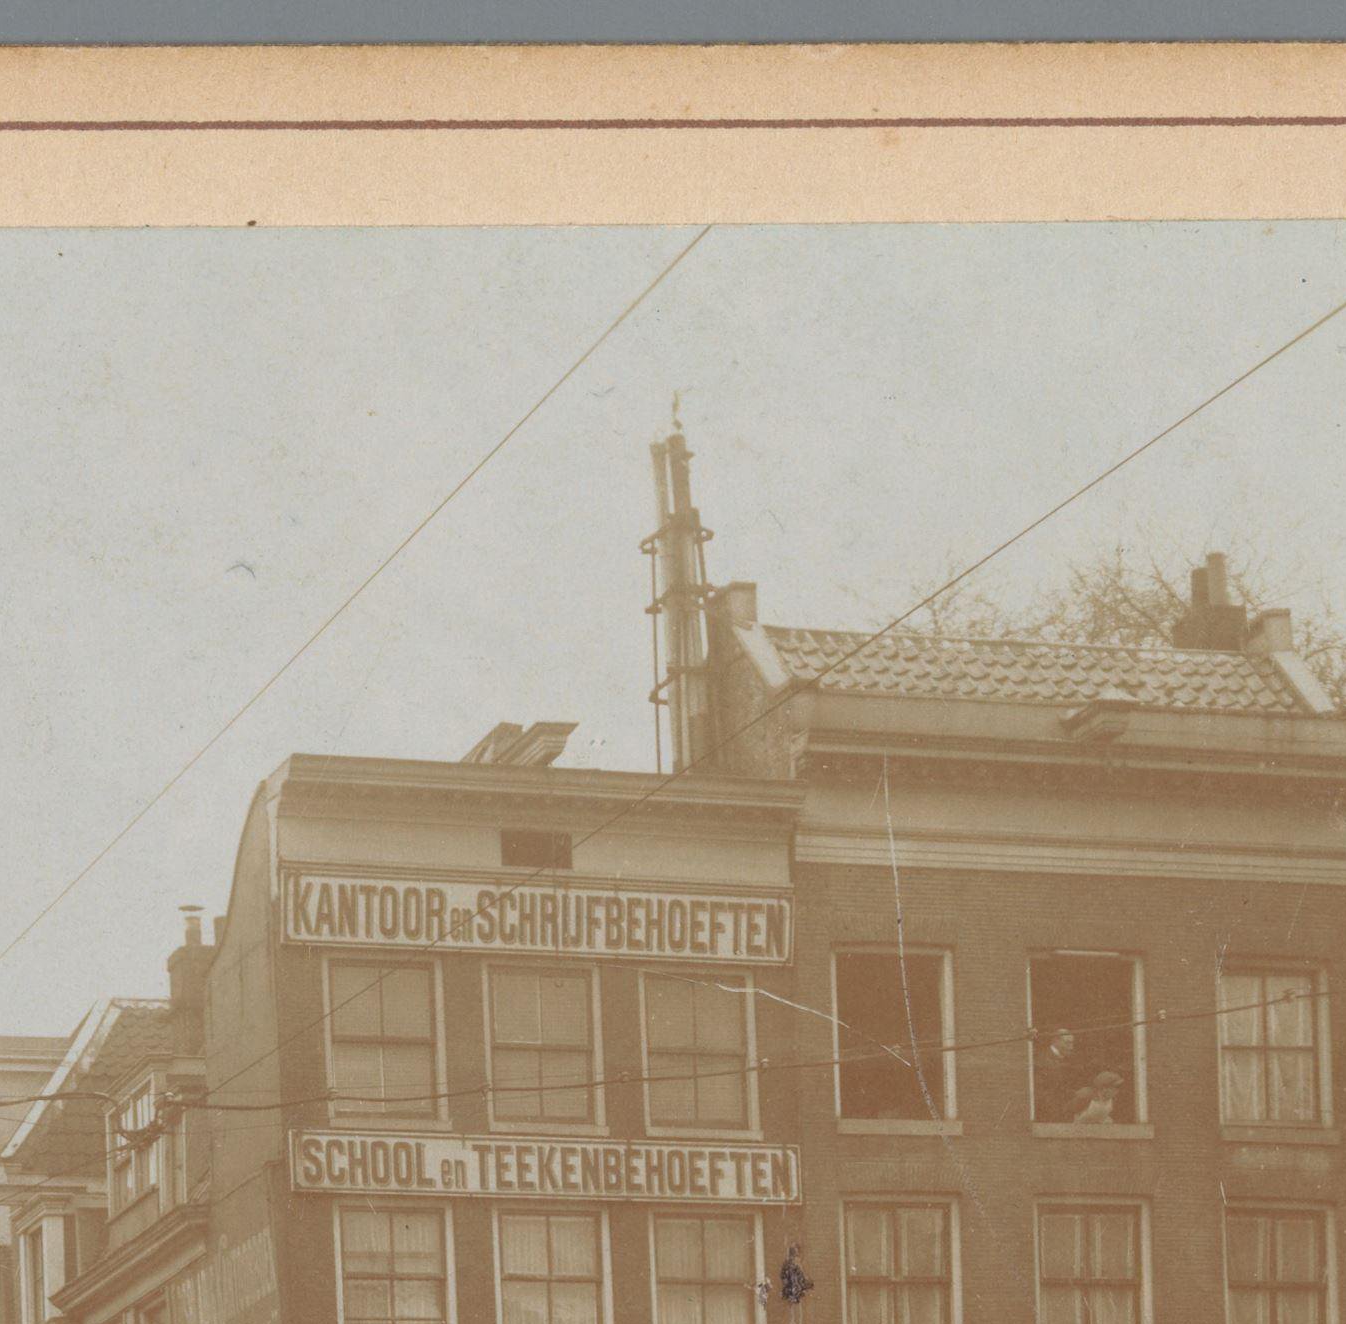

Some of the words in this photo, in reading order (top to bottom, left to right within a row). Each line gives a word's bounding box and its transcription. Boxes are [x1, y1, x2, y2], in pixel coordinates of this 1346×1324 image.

[292, 880, 447, 938] KANTOOR
[450, 905, 475, 942] en
[476, 887, 785, 959] SCHRIJFBEHOEFTEN
[303, 1139, 438, 1189] SCHOOL
[441, 1159, 468, 1190] en
[471, 1144, 792, 1199] TEEKENBEHOEFTEN
